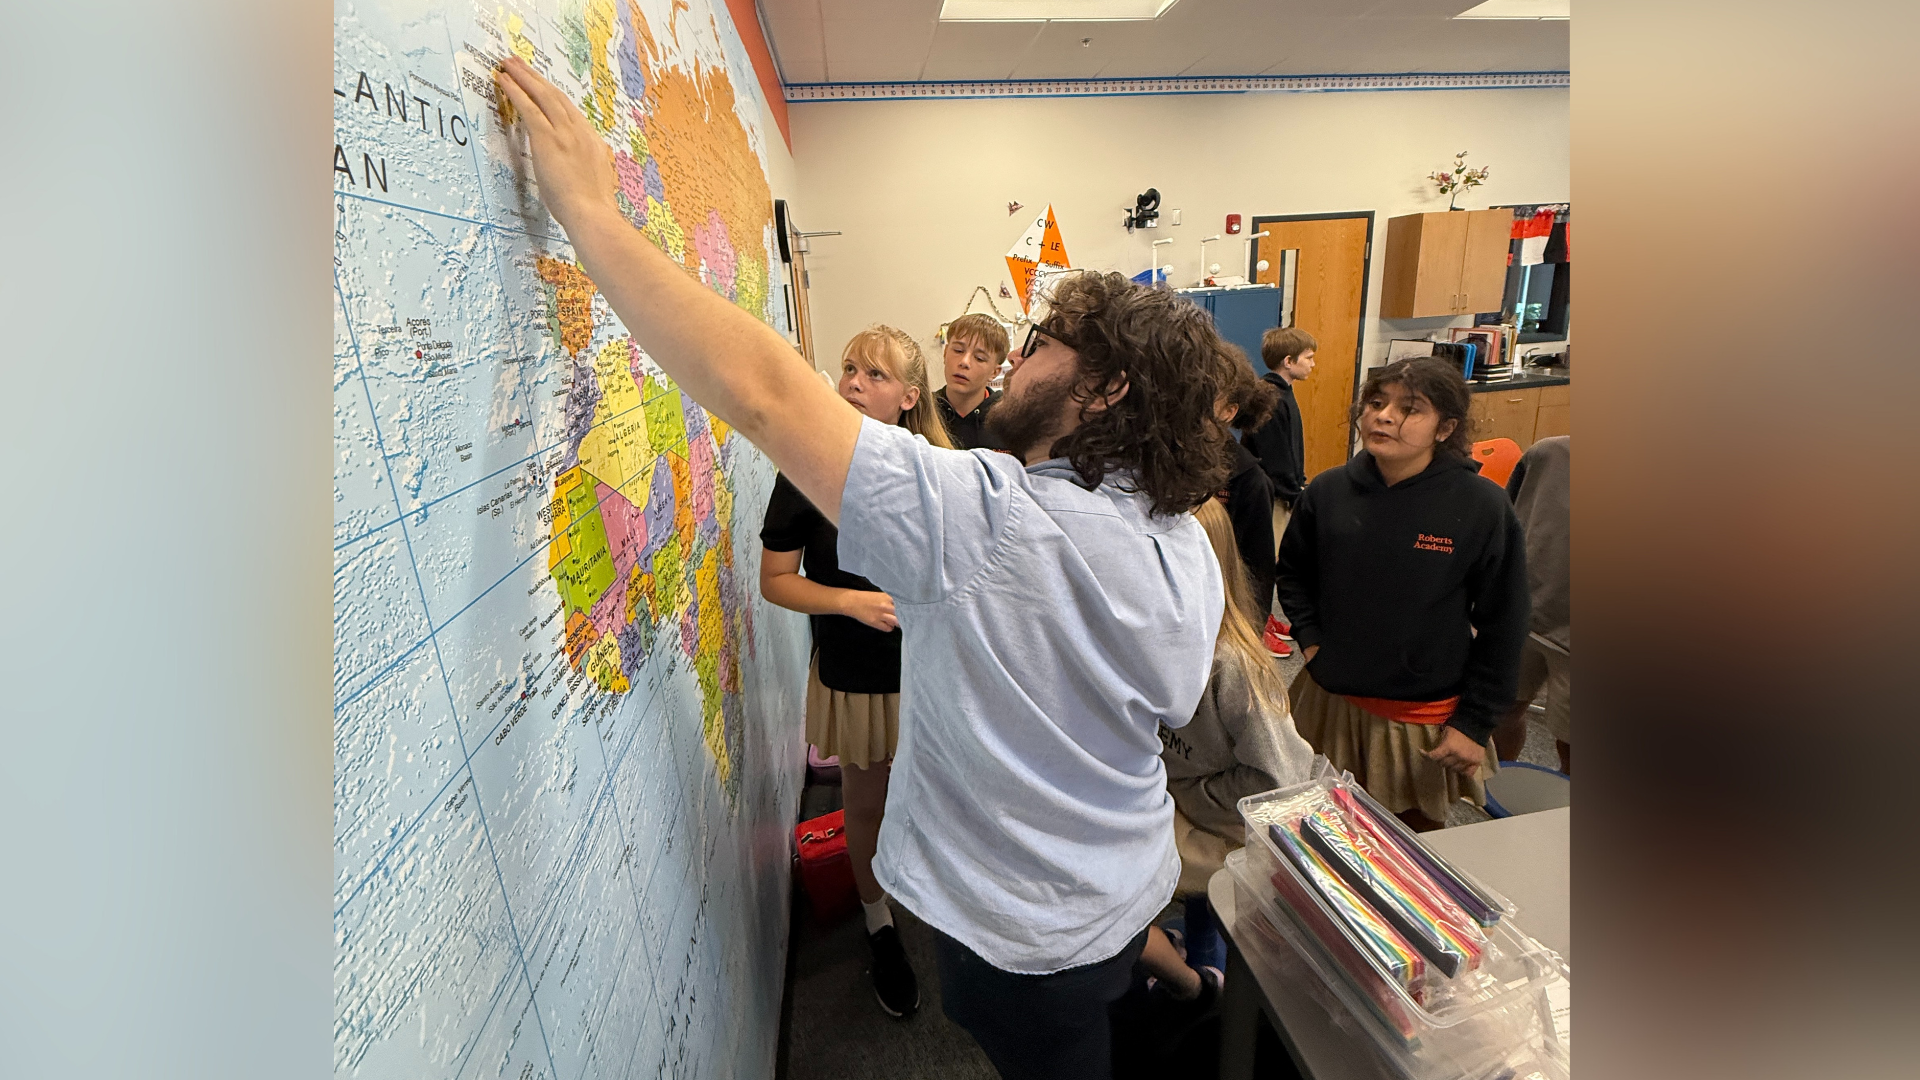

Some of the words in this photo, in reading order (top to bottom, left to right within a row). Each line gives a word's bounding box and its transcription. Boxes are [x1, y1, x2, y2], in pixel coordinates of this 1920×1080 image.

[334, 71, 467, 147] ANTIC
[1026, 236, 1033, 246] C
[1051, 241, 1061, 252] LE
[1012, 253, 1033, 264] Prefix
[1045, 259, 1065, 270] Suffix
[561, 306, 584, 317] SPAIN
[615, 422, 641, 441] ALGERIA
[536, 496, 564, 520] WESTERN
[543, 506, 566, 527] SAHARA
[1413, 541, 1455, 555] Academy
[1417, 533, 1453, 545] Roberts
[570, 545, 607, 587] MAURITANIA
[495, 723, 511, 746] CABO
[511, 703, 528, 727] VERDE
